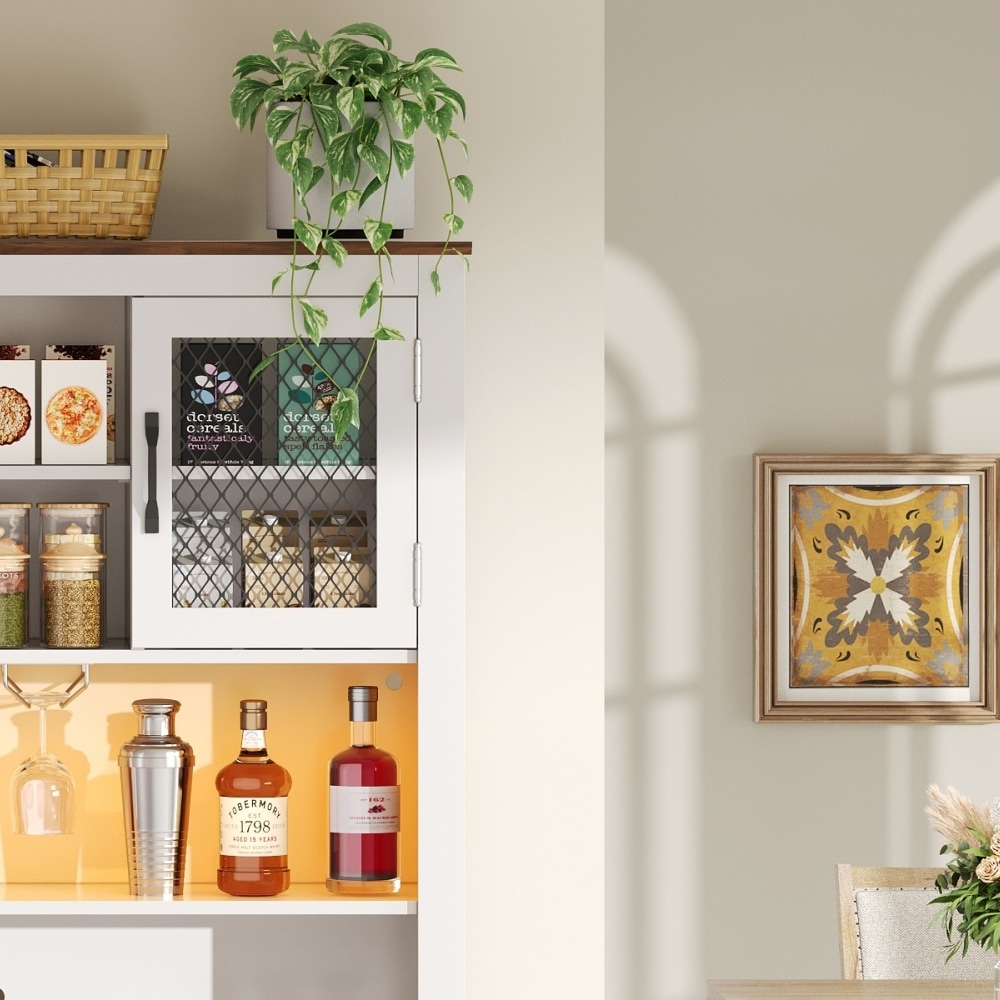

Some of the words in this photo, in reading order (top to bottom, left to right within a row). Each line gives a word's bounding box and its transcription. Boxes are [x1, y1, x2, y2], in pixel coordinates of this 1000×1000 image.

[283, 422, 335, 433] cereal
[228, 799, 281, 819] TOBERMORY
[240, 820, 271, 834] 1798
